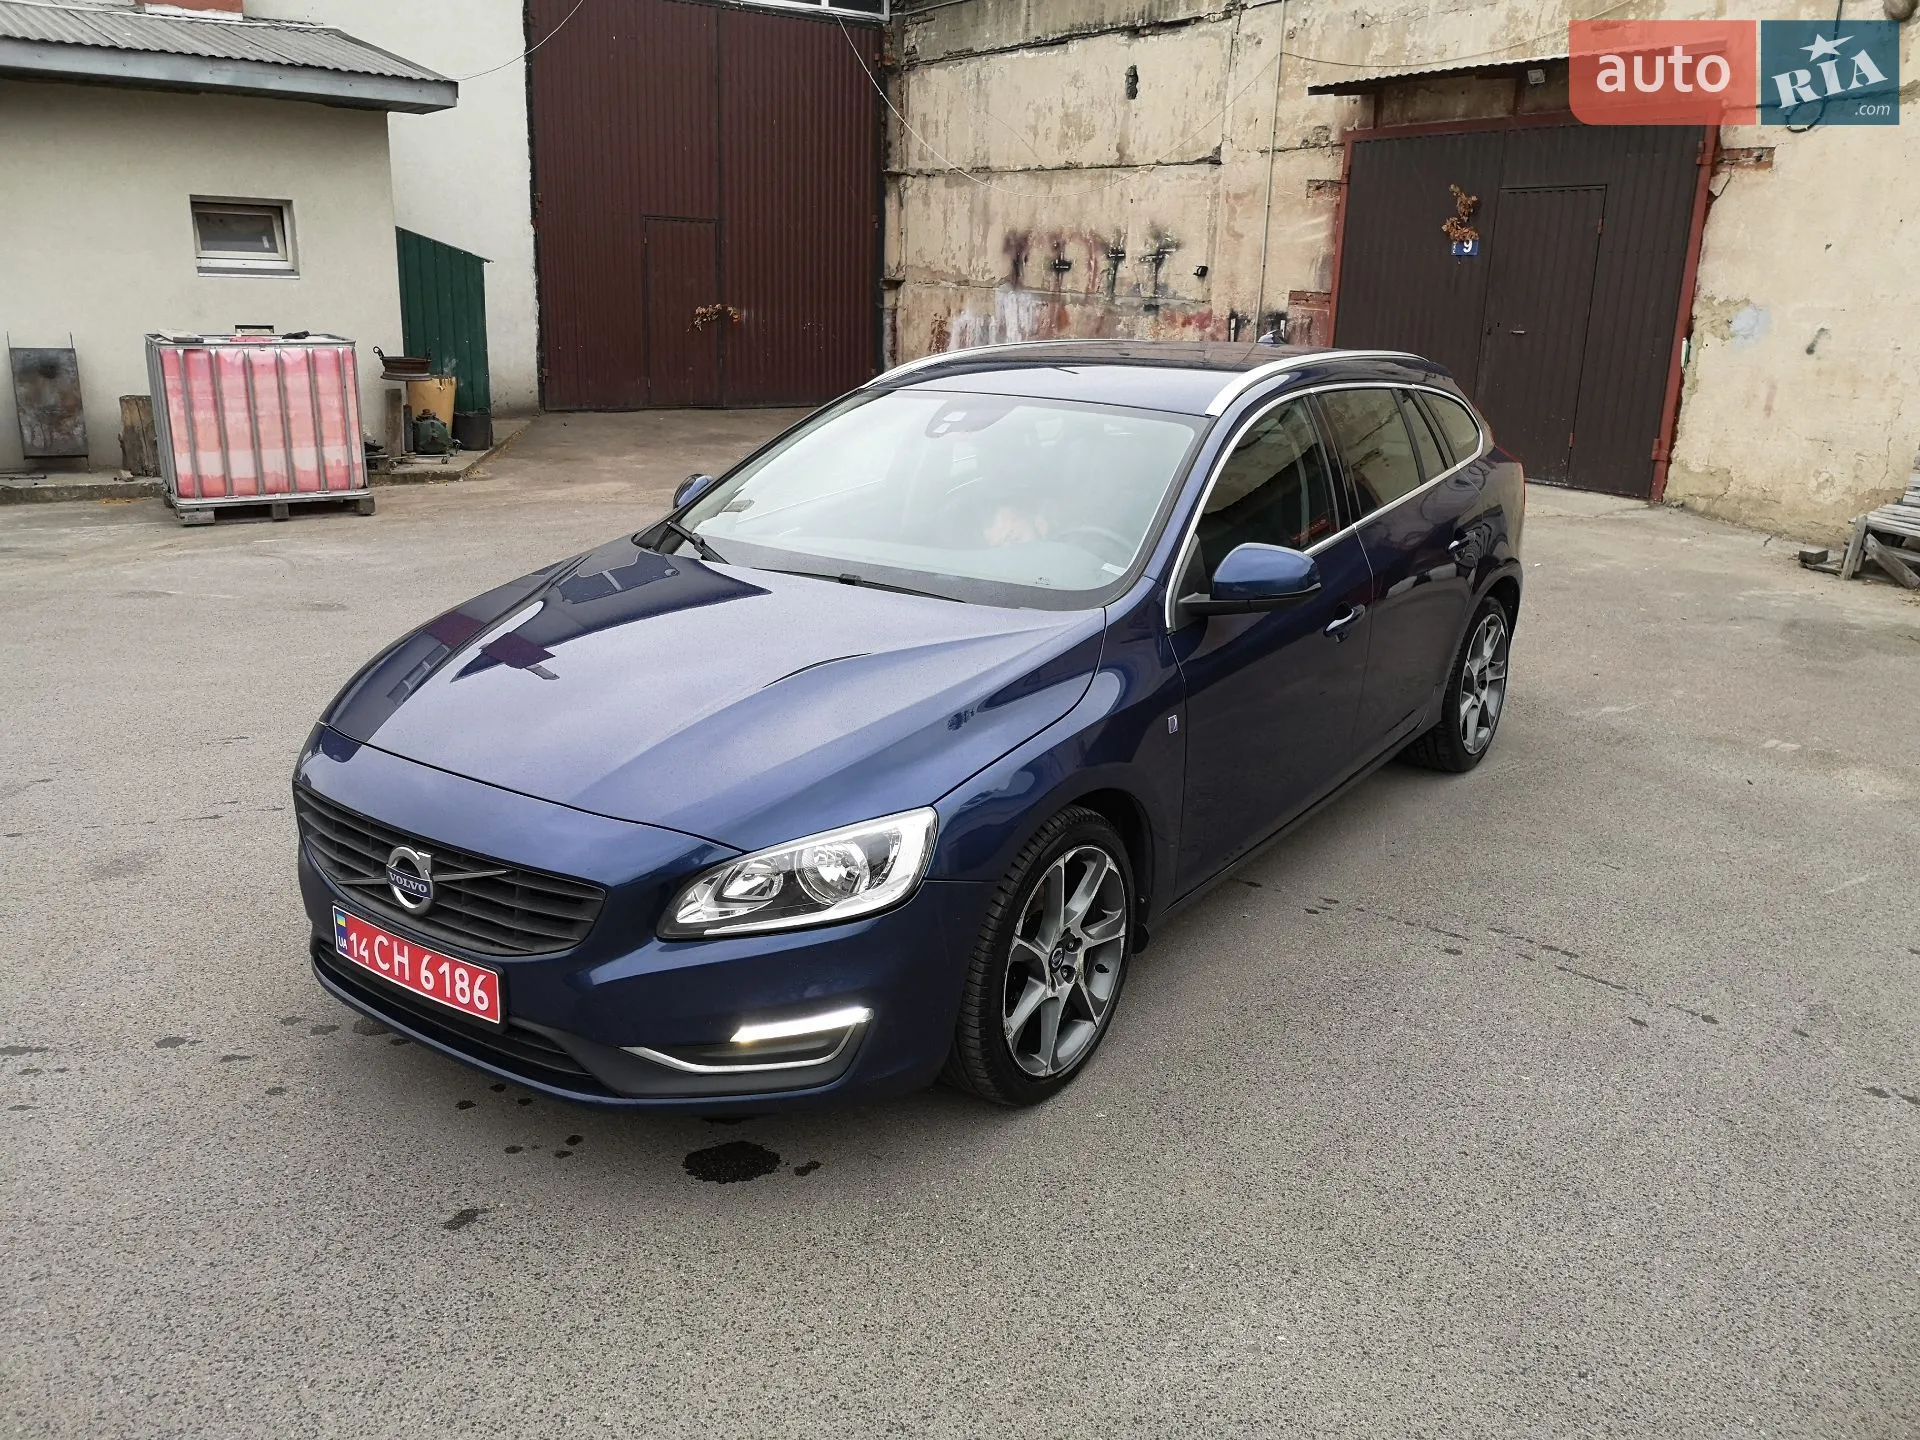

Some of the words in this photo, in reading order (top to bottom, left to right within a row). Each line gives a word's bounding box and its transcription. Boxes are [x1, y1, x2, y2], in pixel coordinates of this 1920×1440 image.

[1463, 238, 1473, 253] 9
[388, 870, 428, 893] VOLVO
[338, 935, 348, 950] UA
[420, 954, 489, 1011] 6186
